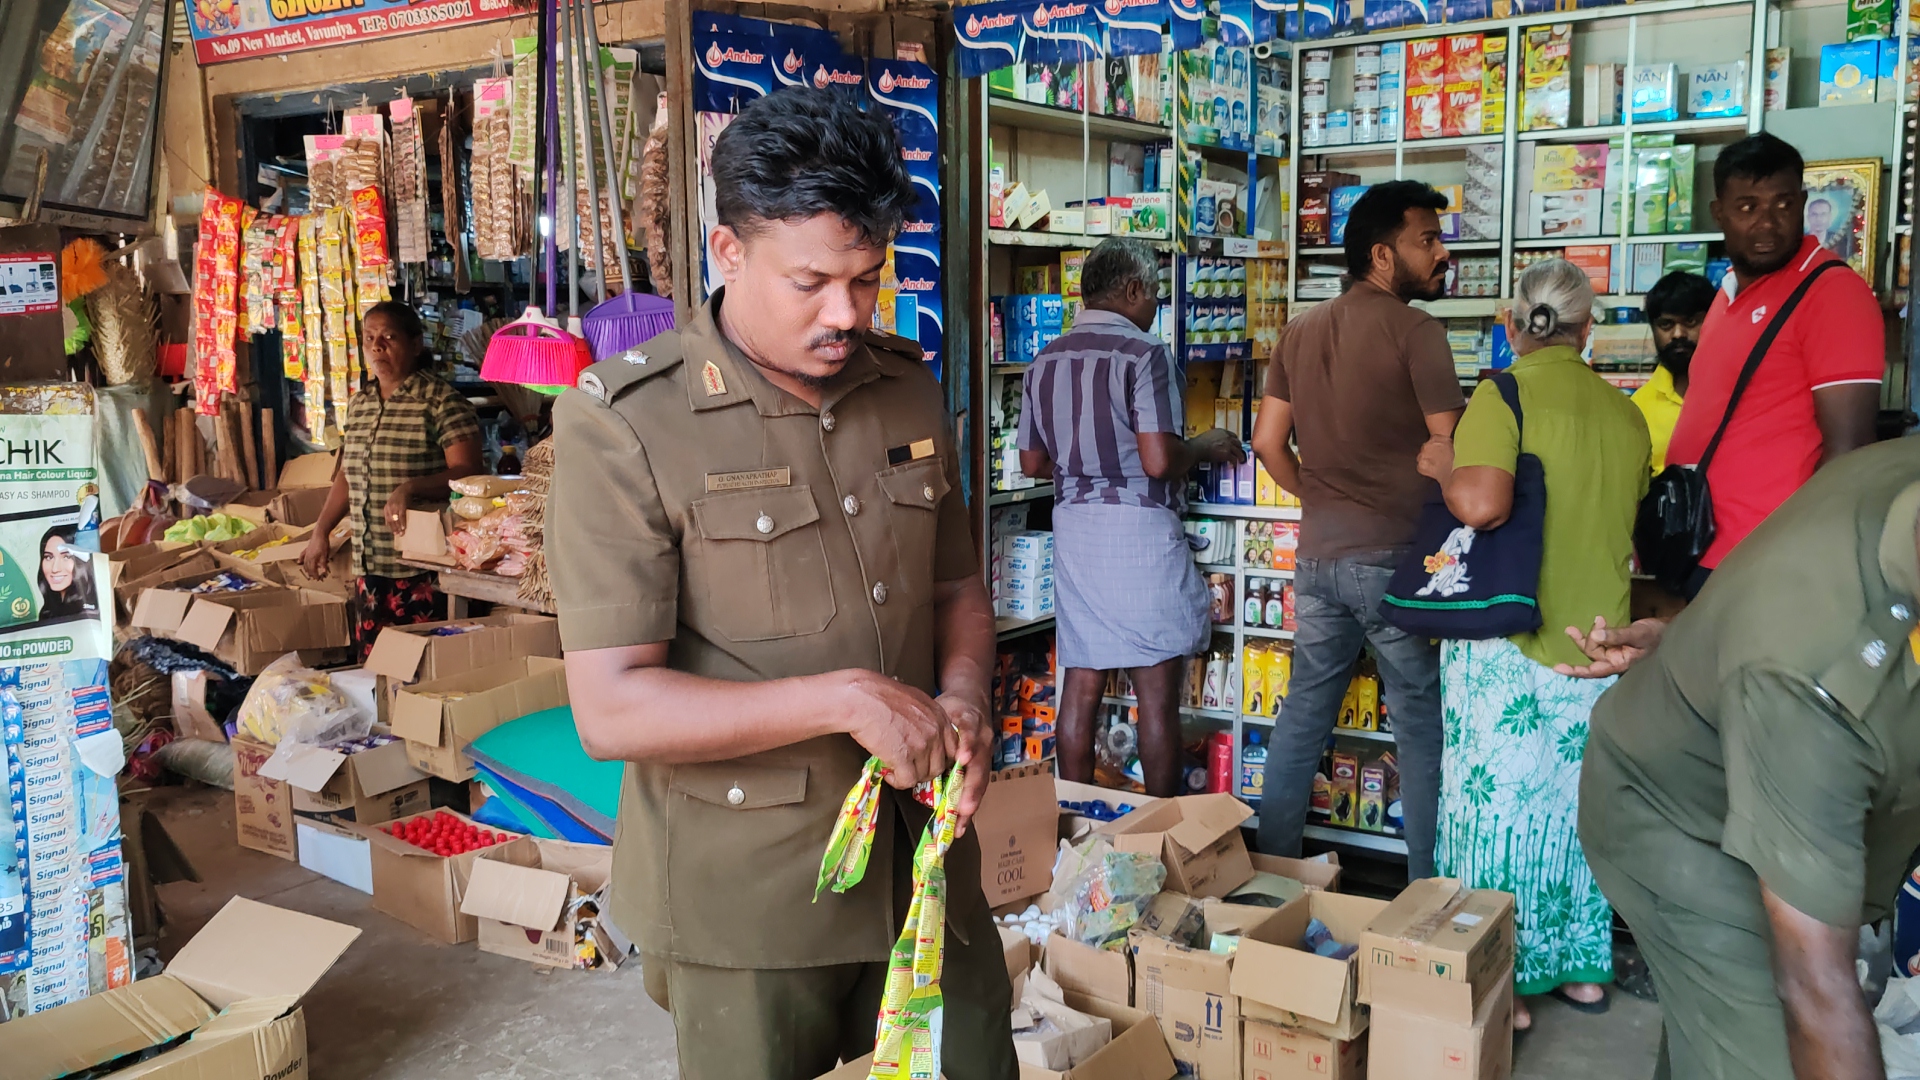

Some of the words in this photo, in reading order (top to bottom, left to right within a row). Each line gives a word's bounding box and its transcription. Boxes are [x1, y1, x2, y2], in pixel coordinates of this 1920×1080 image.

[1050, 4, 1086, 19] Anchor
[211, 37, 240, 56] No.09
[241, 35, 263, 52] New
[264, 29, 306, 48] Market,
[305, 21, 357, 40] Vavuniya.
[359, 16, 387, 33] T.P:
[389, 1, 473, 29] 0703385091
[981, 14, 1015, 29] Anchor
[724, 47, 764, 65] Anchor
[830, 69, 862, 85] Anchor
[894, 74, 930, 89] Anchor
[1695, 71, 1728, 84] NAN
[901, 147, 932, 161] Anchor
[1131, 195, 1161, 205] Anlene
[901, 219, 933, 232] Anchor
[902, 277, 935, 290] Anchor
[0, 437, 64, 465] HIK
[14, 471, 34, 480] Hair
[36, 470, 65, 480] Colour
[0, 491, 15, 500] ASY
[17, 491, 28, 499] AS
[31, 489, 70, 499] SHAMPOO
[23, 640, 71, 655] POWDER
[16, 678, 50, 691] Signal
[20, 697, 52, 710] Signal
[23, 715, 54, 730] Signal
[24, 734, 57, 748] Signal
[26, 753, 59, 767] Signal
[27, 772, 61, 786] Signal
[29, 790, 62, 805] Signal
[31, 809, 64, 824] Signal
[33, 828, 66, 842] Signal
[35, 846, 68, 861] Signal
[36, 864, 69, 880] Signal
[997, 866, 1025, 885] COOL
[30, 885, 61, 900] Signal
[31, 904, 62, 919] Signal
[31, 923, 63, 938] Signal
[32, 942, 64, 957] Signal
[32, 960, 65, 975] Signal
[34, 978, 66, 994] Signal
[263, 1057, 302, 1080] Powder
